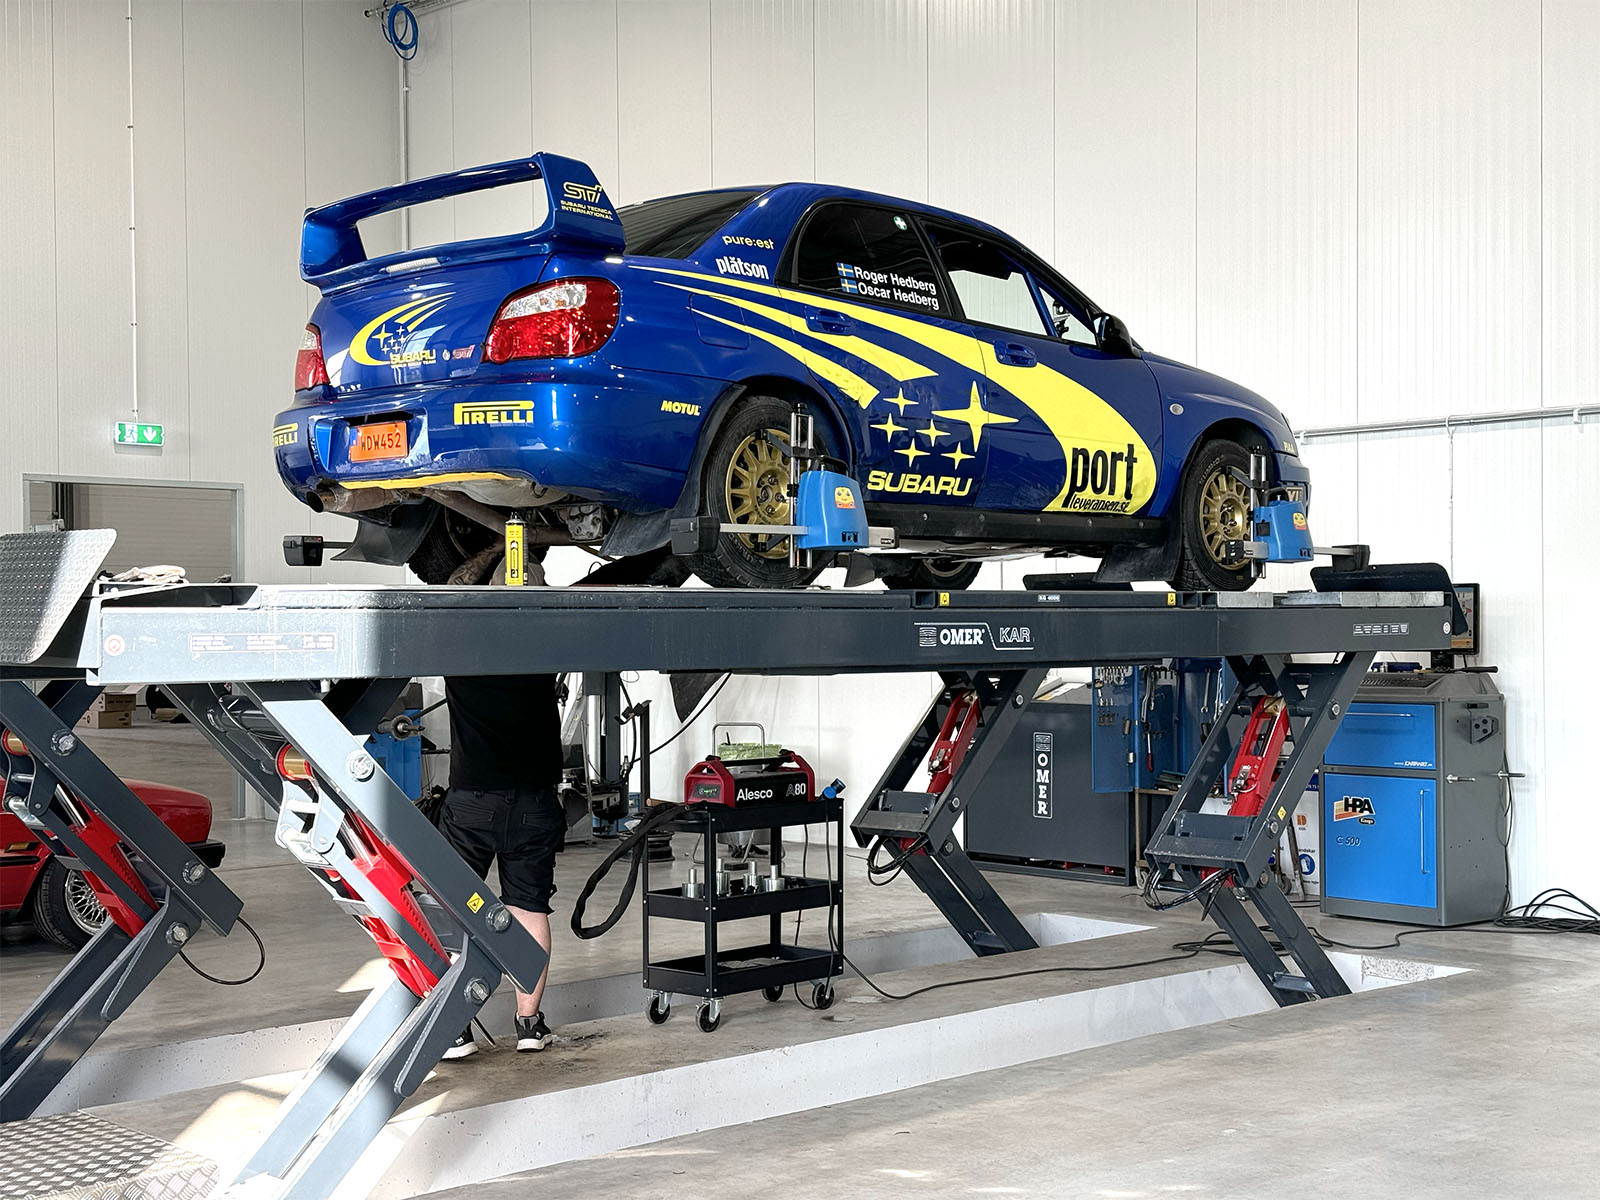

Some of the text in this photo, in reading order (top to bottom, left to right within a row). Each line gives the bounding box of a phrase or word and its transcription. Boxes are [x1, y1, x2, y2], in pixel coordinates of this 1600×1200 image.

[560, 200, 612, 215] SUBARU TECNICA
[561, 205, 613, 220] INTERNATIONAL
[722, 235, 774, 250] pure:est
[853, 266, 937, 295] Roger Hedberg
[858, 281, 940, 310] Oscar Hedberg
[390, 349, 436, 364] SUBARU
[454, 400, 535, 425] PIRELLI
[660, 400, 701, 416] MOTUL
[272, 423, 299, 447] RELLI
[867, 470, 973, 496] SUBARU
[1061, 443, 1138, 508] port
[1069, 494, 1131, 513] leveransen.se
[940, 627, 1031, 645] OMER KAR
[736, 783, 806, 801] Alesco A80
[1036, 753, 1050, 815] OMER
[1344, 797, 1374, 814] HPA
[1336, 836, 1361, 847] C 500
